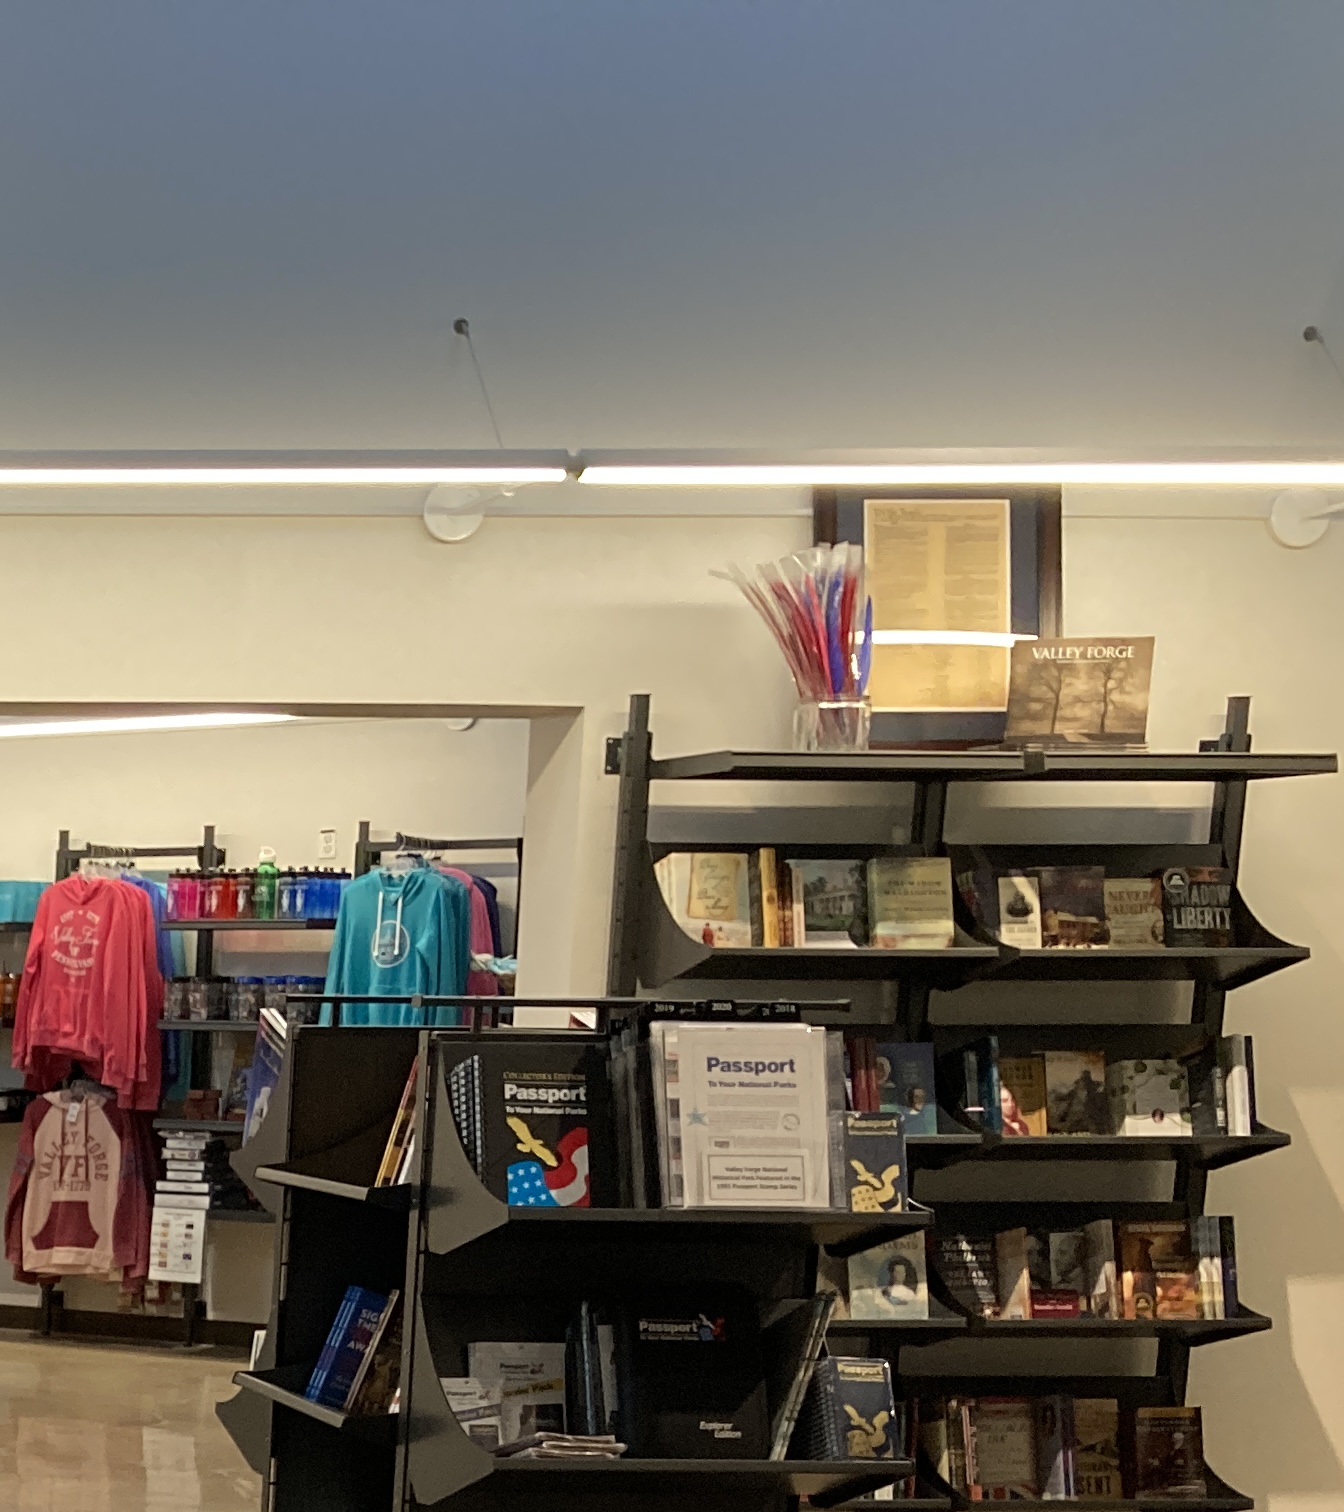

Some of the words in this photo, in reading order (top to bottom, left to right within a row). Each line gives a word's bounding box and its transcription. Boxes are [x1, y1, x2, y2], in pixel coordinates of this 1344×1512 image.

[1032, 647, 1083, 660] VALLEY
[1087, 645, 1135, 660] FORGE
[1172, 906, 1231, 930] LIBERTY
[706, 1056, 796, 1077] Passport
[504, 1083, 587, 1103] Passport
[638, 1320, 697, 1334] Passport
